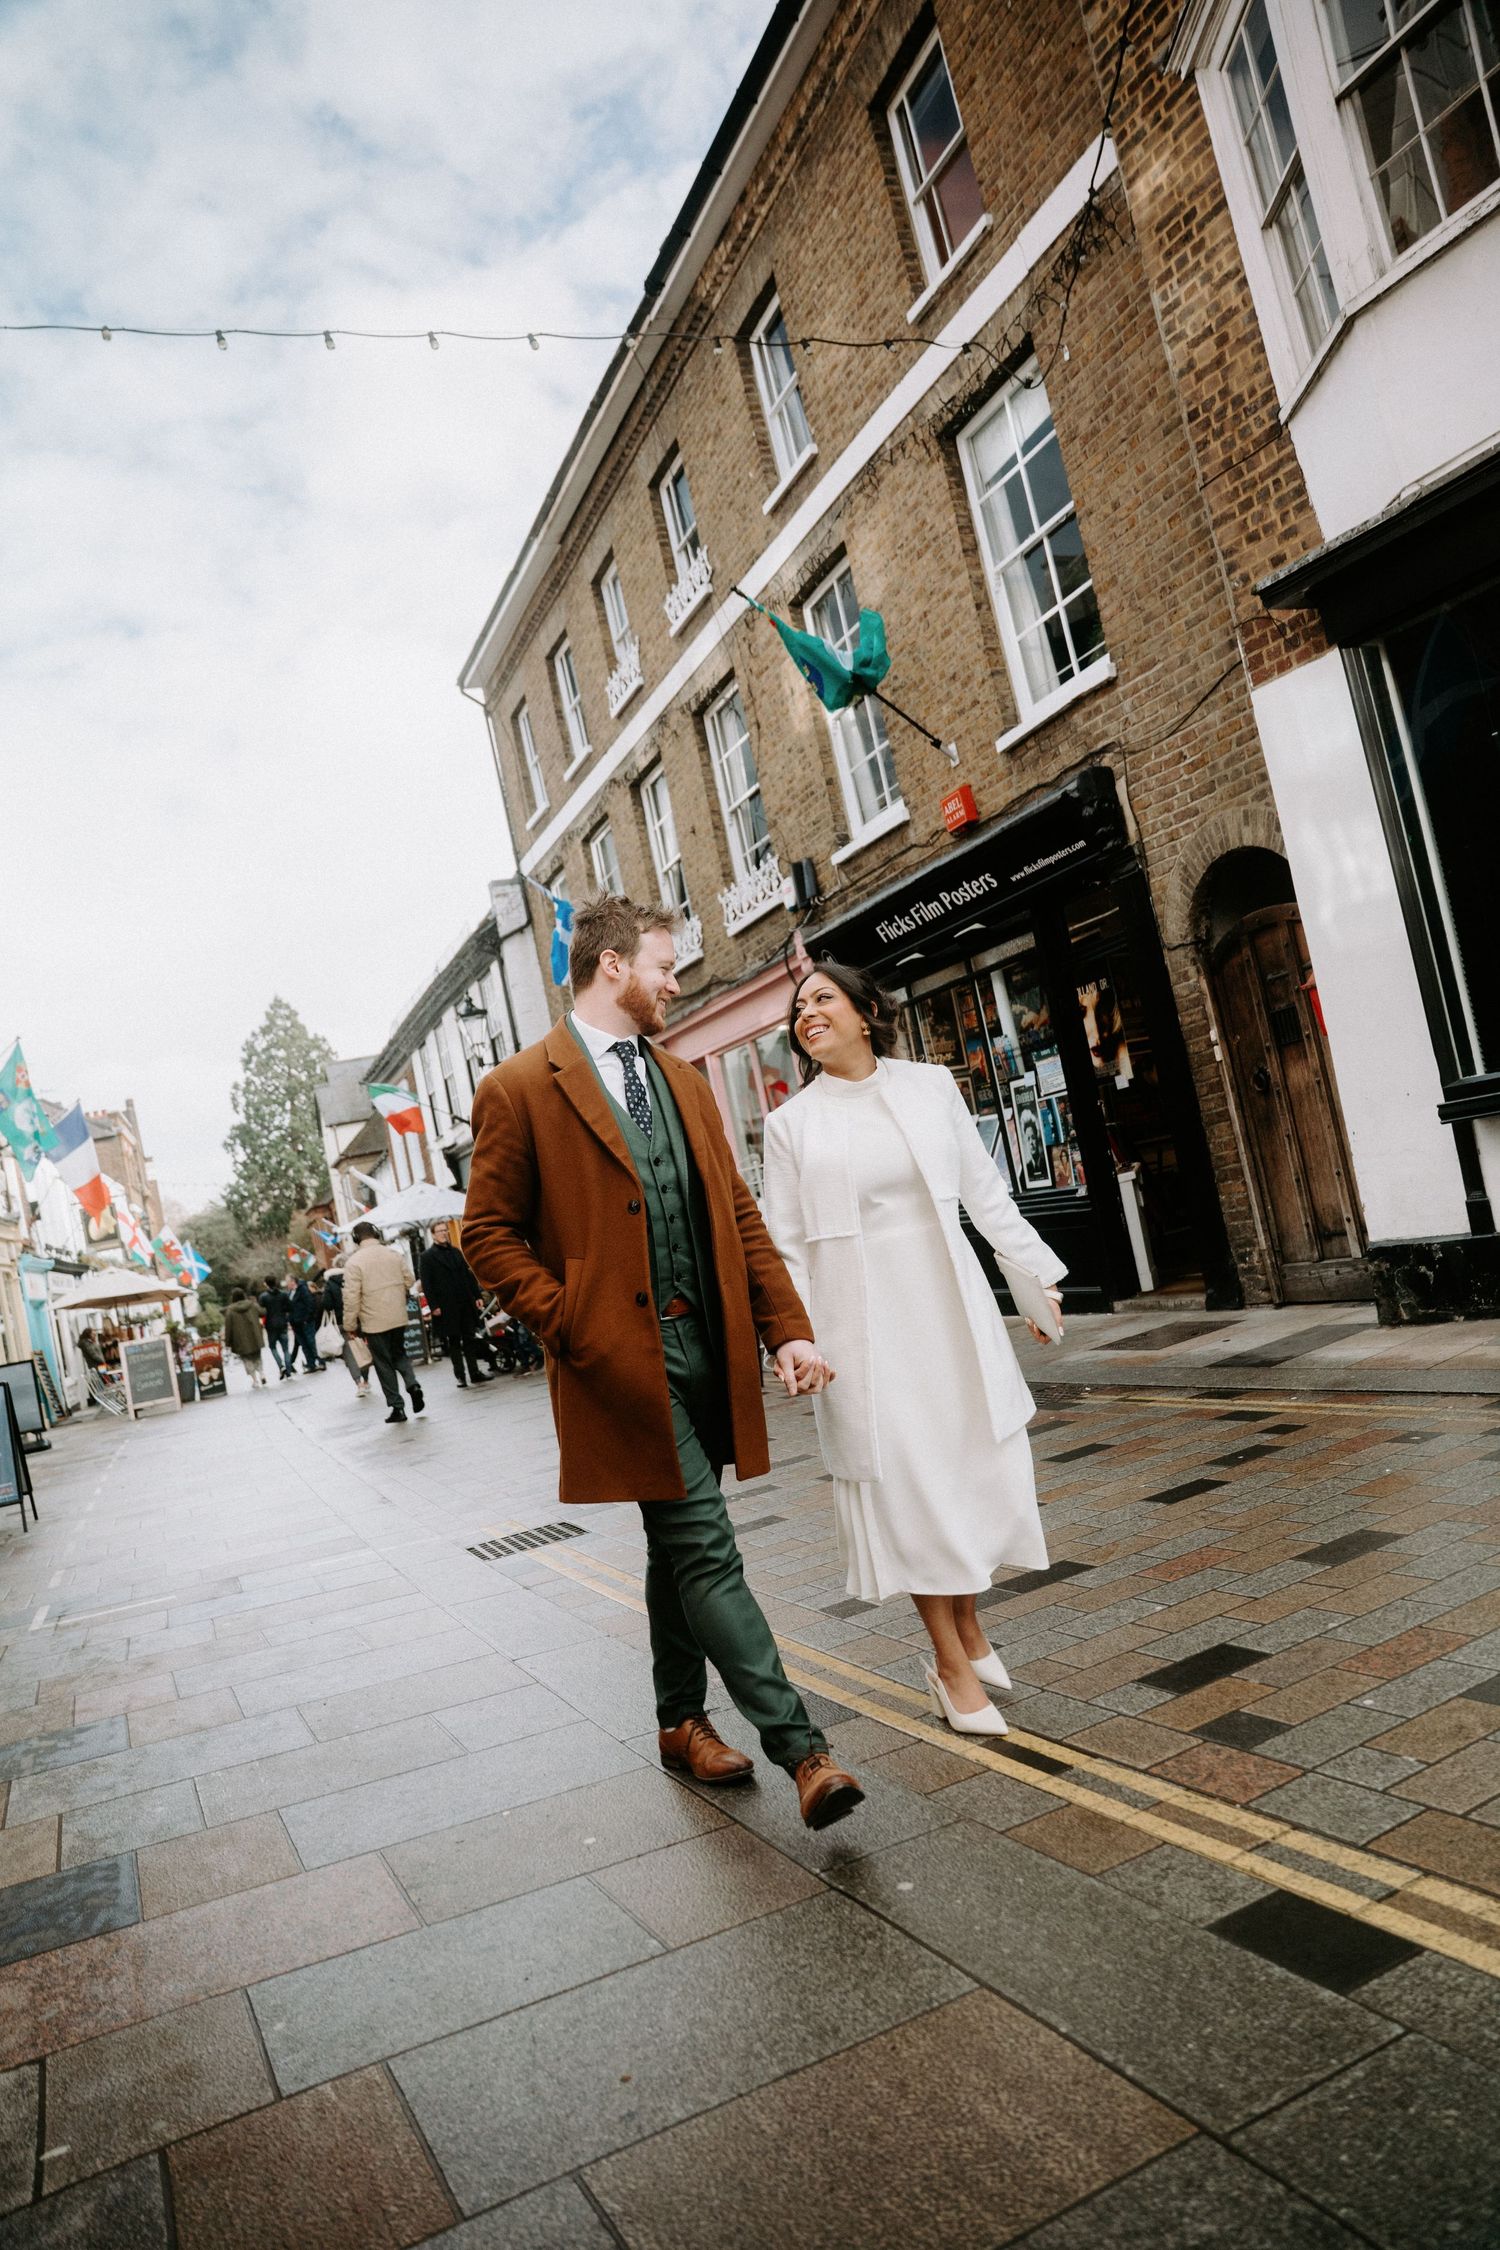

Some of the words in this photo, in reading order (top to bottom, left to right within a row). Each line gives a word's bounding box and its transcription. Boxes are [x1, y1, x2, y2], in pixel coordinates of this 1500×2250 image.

[944, 797, 961, 815] ABEL
[1010, 840, 1087, 882] www.flicksfilmposters.com
[875, 914, 916, 943] Flicks
[909, 901, 945, 926] Film
[939, 873, 998, 910] Posters
